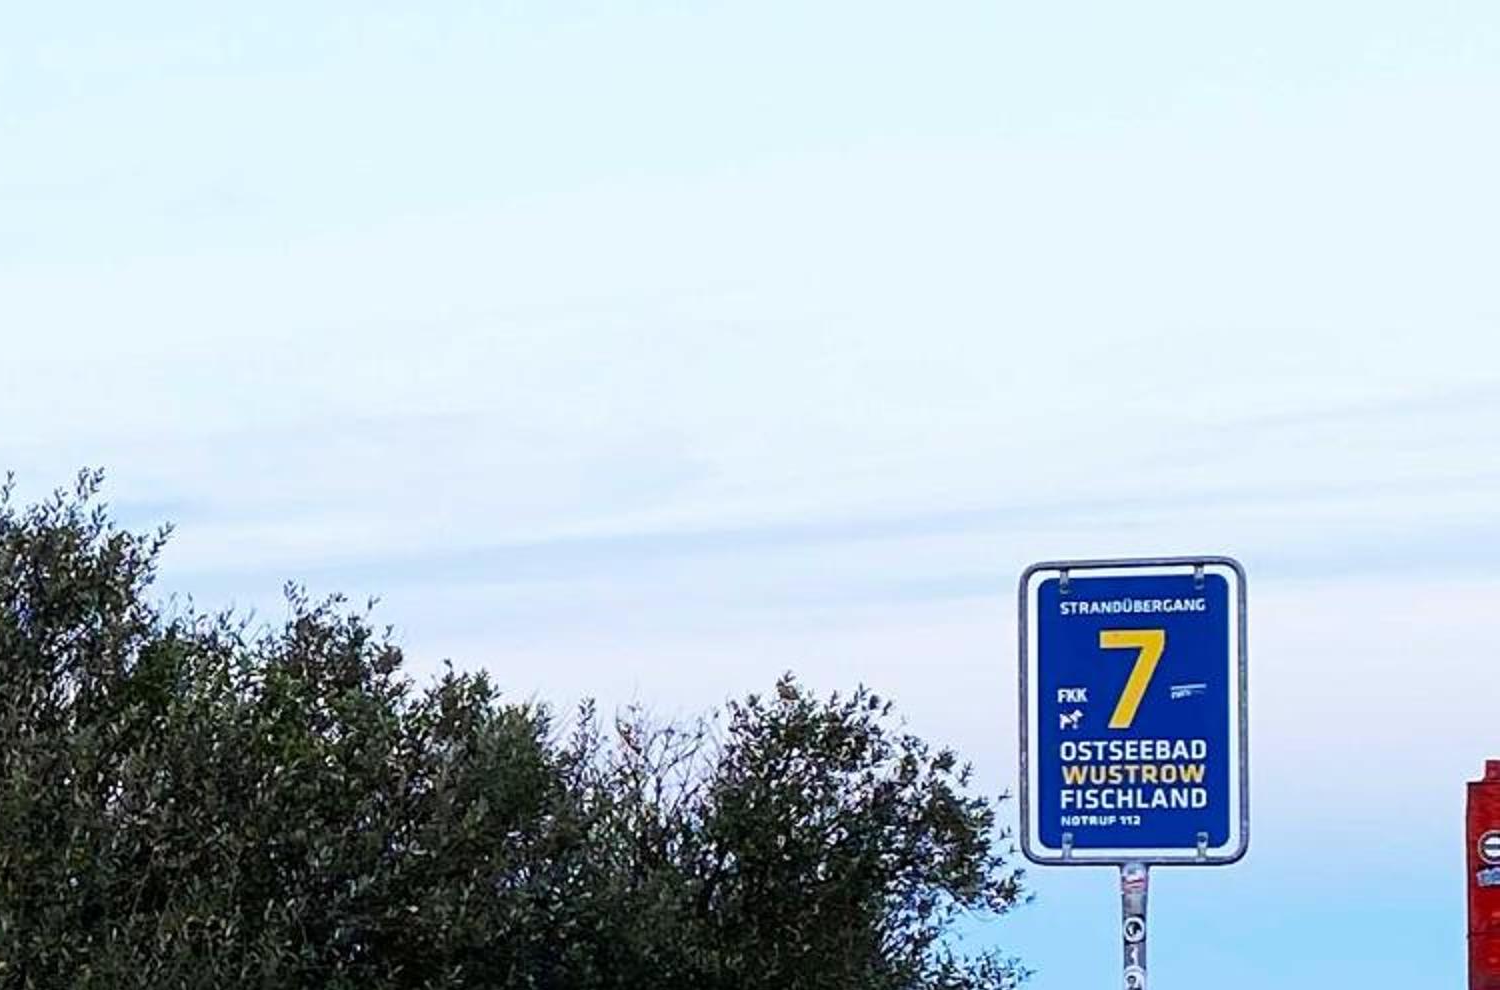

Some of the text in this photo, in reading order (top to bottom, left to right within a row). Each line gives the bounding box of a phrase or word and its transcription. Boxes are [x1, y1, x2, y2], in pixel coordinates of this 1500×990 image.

[1060, 598, 1206, 615] STRANDÜBERGANG
[1099, 629, 1166, 729] 7
[1057, 688, 1088, 703] FKK
[1060, 739, 1207, 761] OSTSEEBAD
[1061, 764, 1205, 785] WUSTROW
[1060, 788, 1208, 809] FISCHLAND
[1060, 815, 1141, 827] NOTRUF 112
